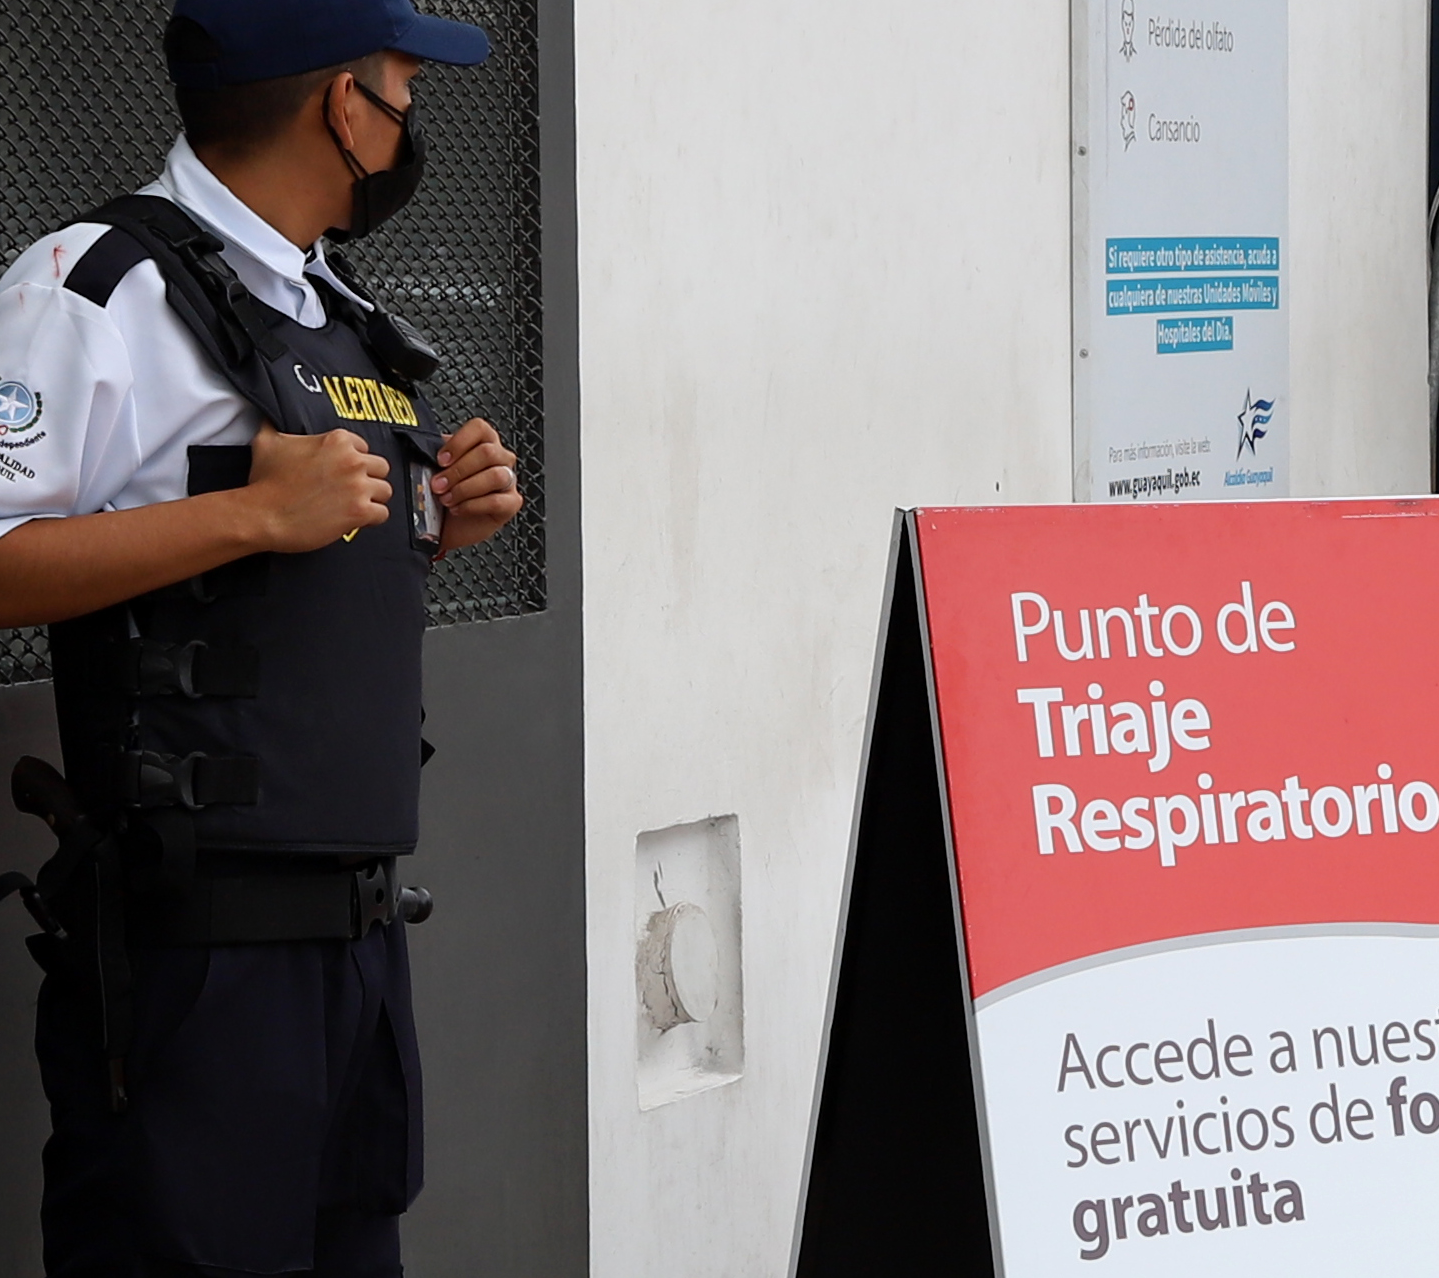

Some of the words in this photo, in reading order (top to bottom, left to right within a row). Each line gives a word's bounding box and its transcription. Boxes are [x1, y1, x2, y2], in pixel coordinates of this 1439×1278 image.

[1148, 16, 1186, 48] Pérdida
[1188, 20, 1203, 49] del
[1206, 21, 1234, 52] olfato
[1148, 113, 1200, 143] Cansancio
[1109, 245, 1117, 268] Si
[1119, 245, 1154, 272] requiere
[1156, 247, 1173, 266] otro
[1175, 244, 1191, 270] tipo
[1193, 244, 1204, 266] de
[1205, 244, 1246, 269] asistencia,
[1248, 244, 1271, 265] acuda
[1272, 249, 1277, 265] a
[1109, 284, 1154, 312] cualquiera
[1155, 284, 1166, 310] de
[1167, 285, 1202, 304] nuestras
[1204, 282, 1240, 303] Unidades
[1242, 279, 1270, 303] Móviles
[1271, 286, 1277, 307] y
[1157, 321, 1200, 349] Hospitales
[1202, 320, 1215, 342] del
[1216, 317, 1232, 341] Día.
[323, 376, 392, 423] ALERTA
[1109, 467, 1200, 498] www.guayaquil.gob.ec
[1010, 591, 1202, 663] Punto
[1217, 580, 1296, 654] de
[1017, 680, 1211, 772] Triaje
[1057, 1018, 1253, 1093] Accede
[1269, 1030, 1297, 1075] a
[1064, 1095, 1294, 1169] servicios
[1309, 1083, 1374, 1145] de
[1072, 1167, 1306, 1261] gratuita
